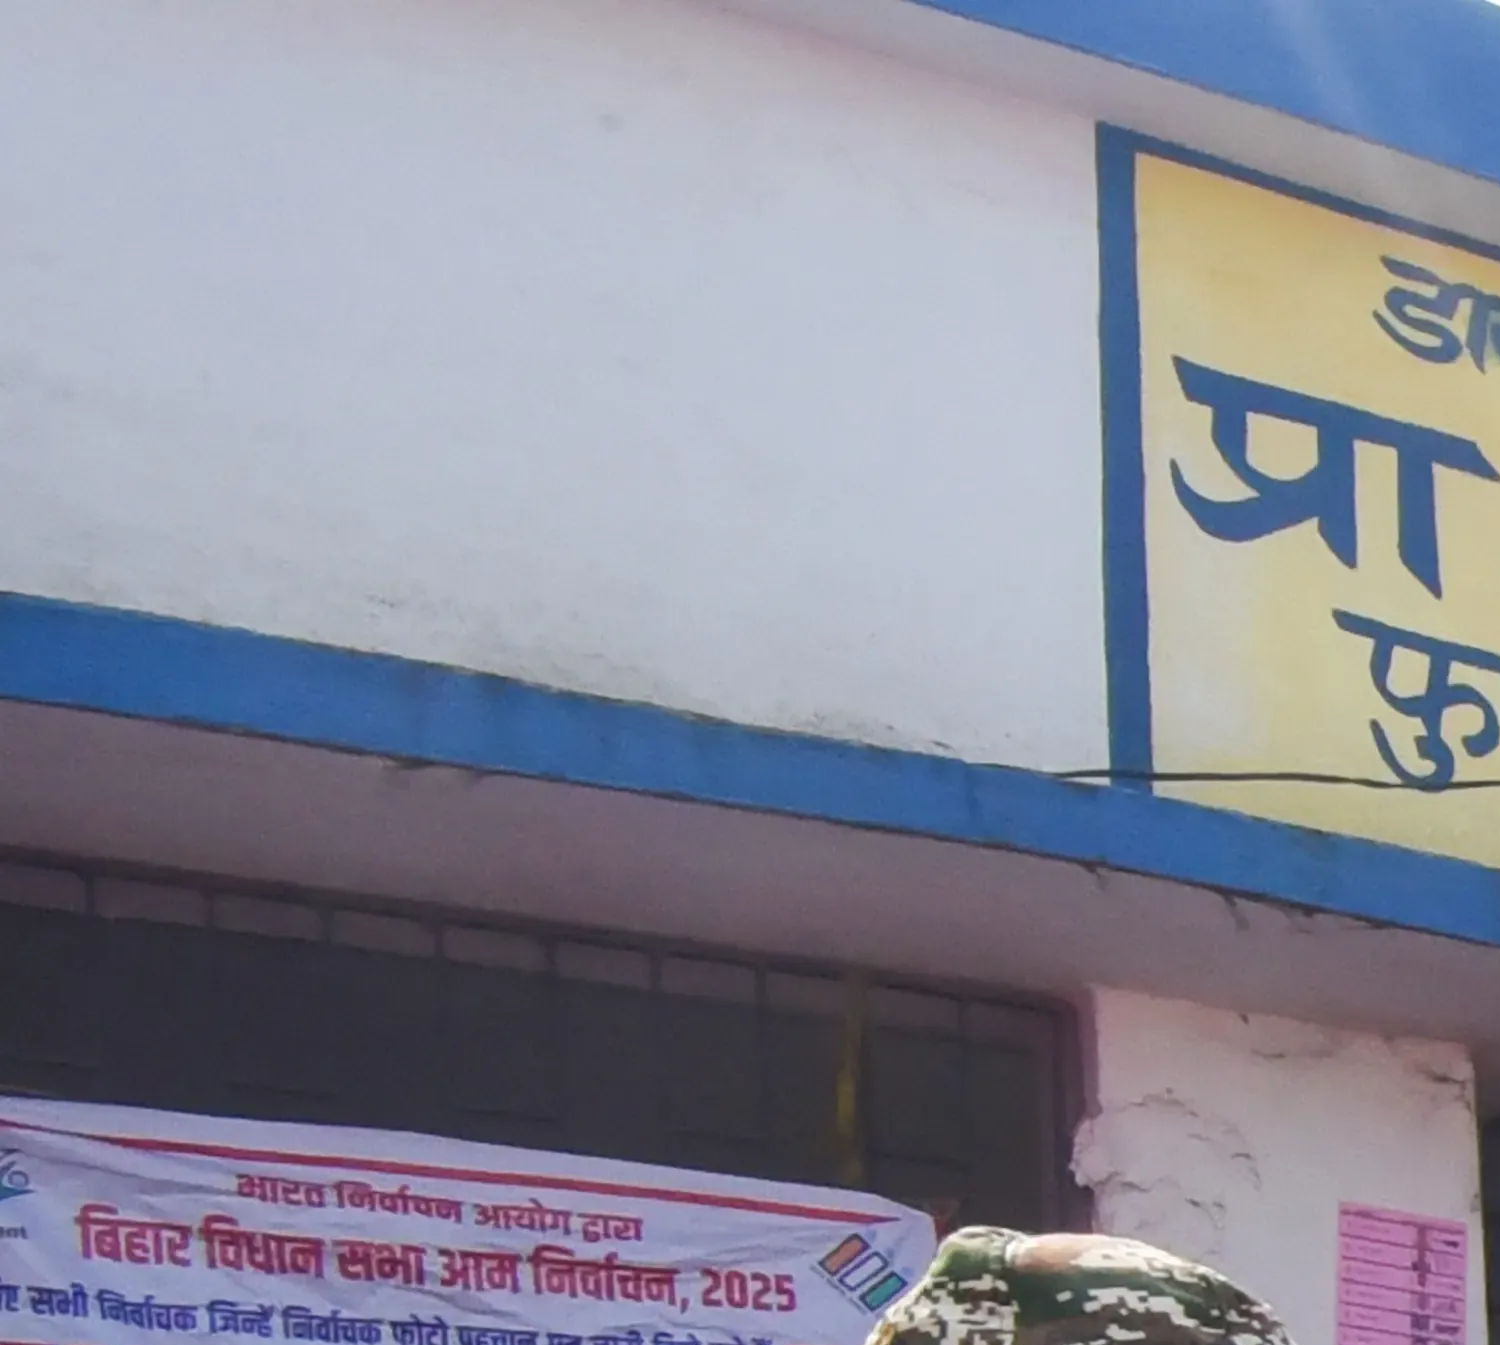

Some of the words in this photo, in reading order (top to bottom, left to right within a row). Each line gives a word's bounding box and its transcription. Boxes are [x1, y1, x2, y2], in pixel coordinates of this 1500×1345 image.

[236, 1174, 330, 1209] भारत
[333, 1180, 463, 1225] निर्वाचन
[475, 1199, 571, 1236] आयोग
[577, 1212, 644, 1244] द्वारा
[75, 1203, 192, 1267] बिहार
[198, 1215, 325, 1279] विधान
[331, 1239, 423, 1288] सभा
[438, 1246, 521, 1295] आम
[527, 1245, 691, 1315] निर्वाचन,
[700, 1269, 797, 1313] 2025
[26, 1283, 88, 1318] सभी
[96, 1288, 197, 1335] निर्वाचक
[206, 1299, 274, 1339] जिन्हें
